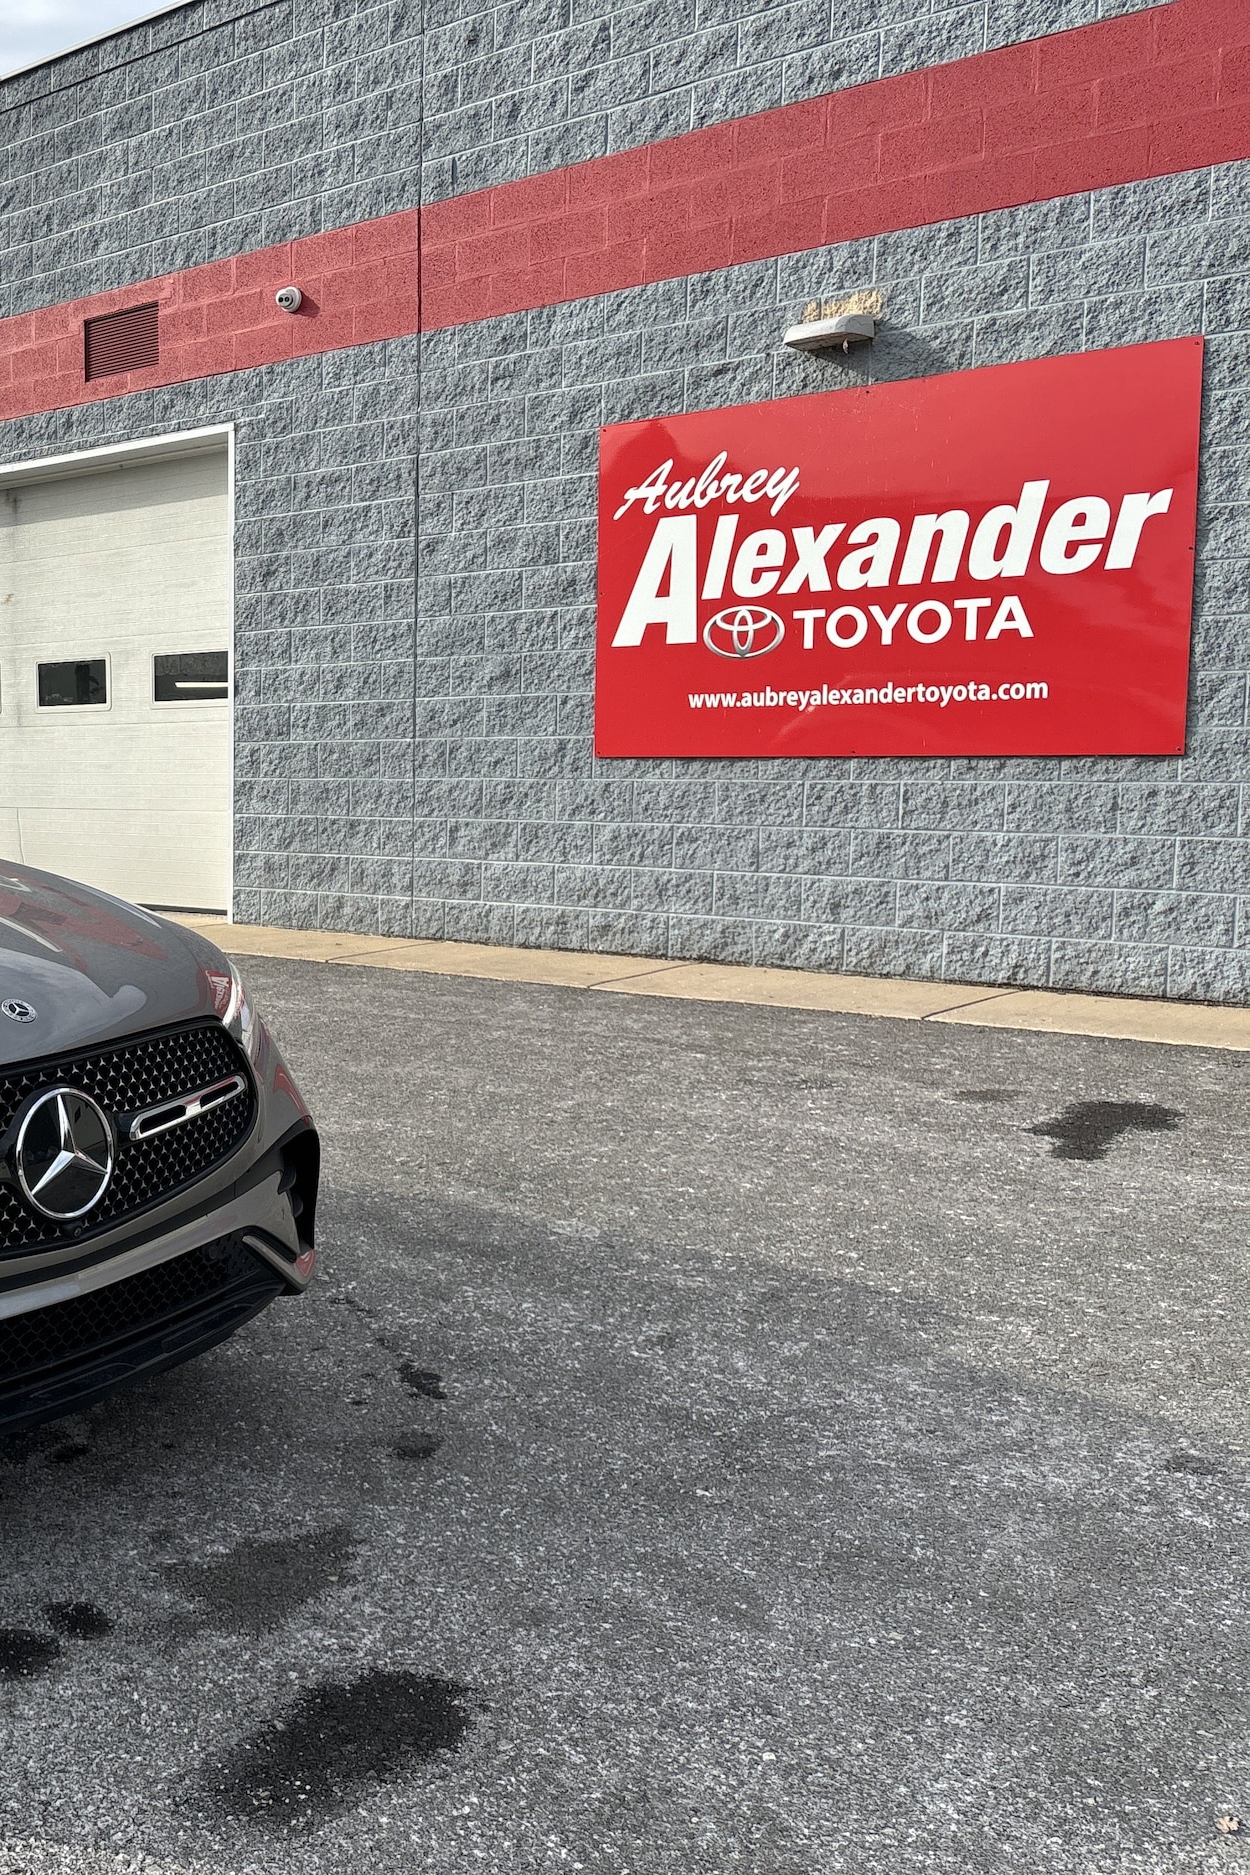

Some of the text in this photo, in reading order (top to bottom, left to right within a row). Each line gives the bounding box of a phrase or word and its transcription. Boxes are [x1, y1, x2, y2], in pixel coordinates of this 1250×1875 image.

[613, 450, 800, 519] Aubrey
[611, 480, 1173, 648] Alexander
[793, 595, 1035, 649] TOYOTA
[688, 680, 1049, 714] www.aubreyalexandertoyota.com
